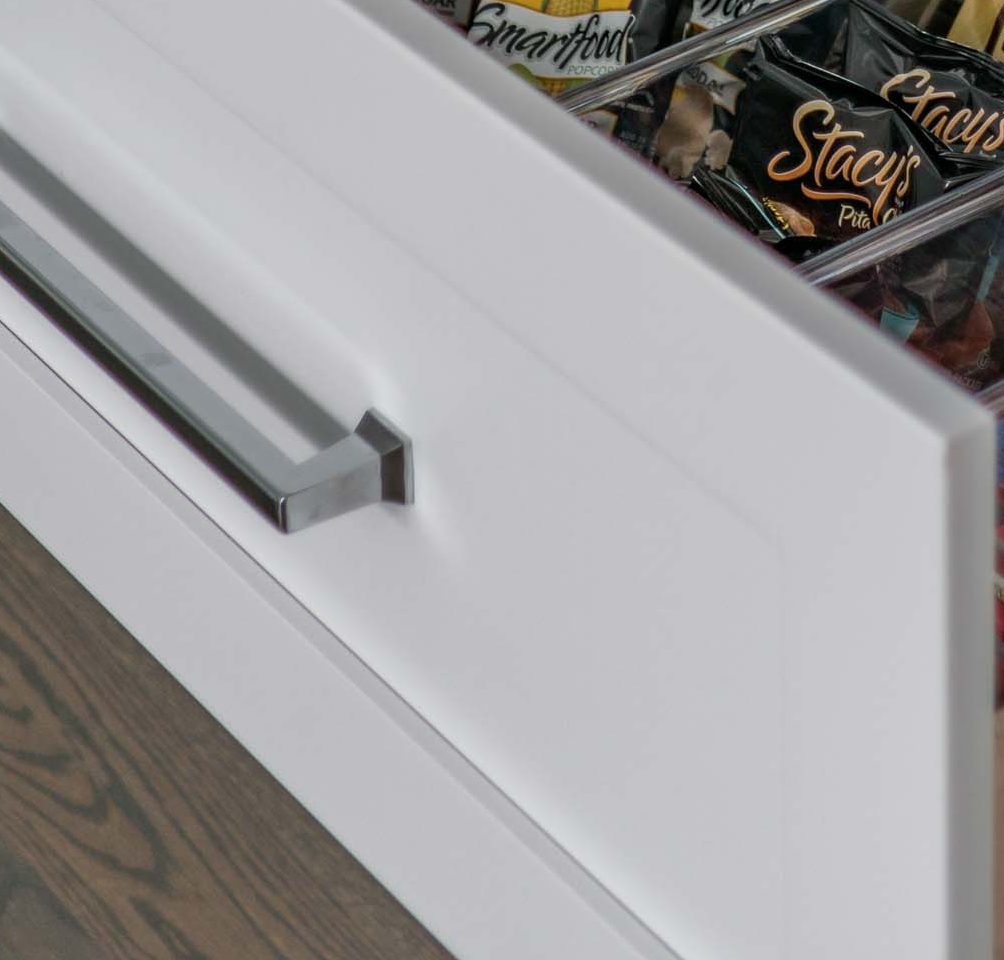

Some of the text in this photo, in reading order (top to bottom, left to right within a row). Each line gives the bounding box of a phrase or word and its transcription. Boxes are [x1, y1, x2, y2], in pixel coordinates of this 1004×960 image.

[470, 1, 635, 69] Smartfood
[767, 99, 922, 226] Stacy's
[838, 203, 871, 230] Pita
